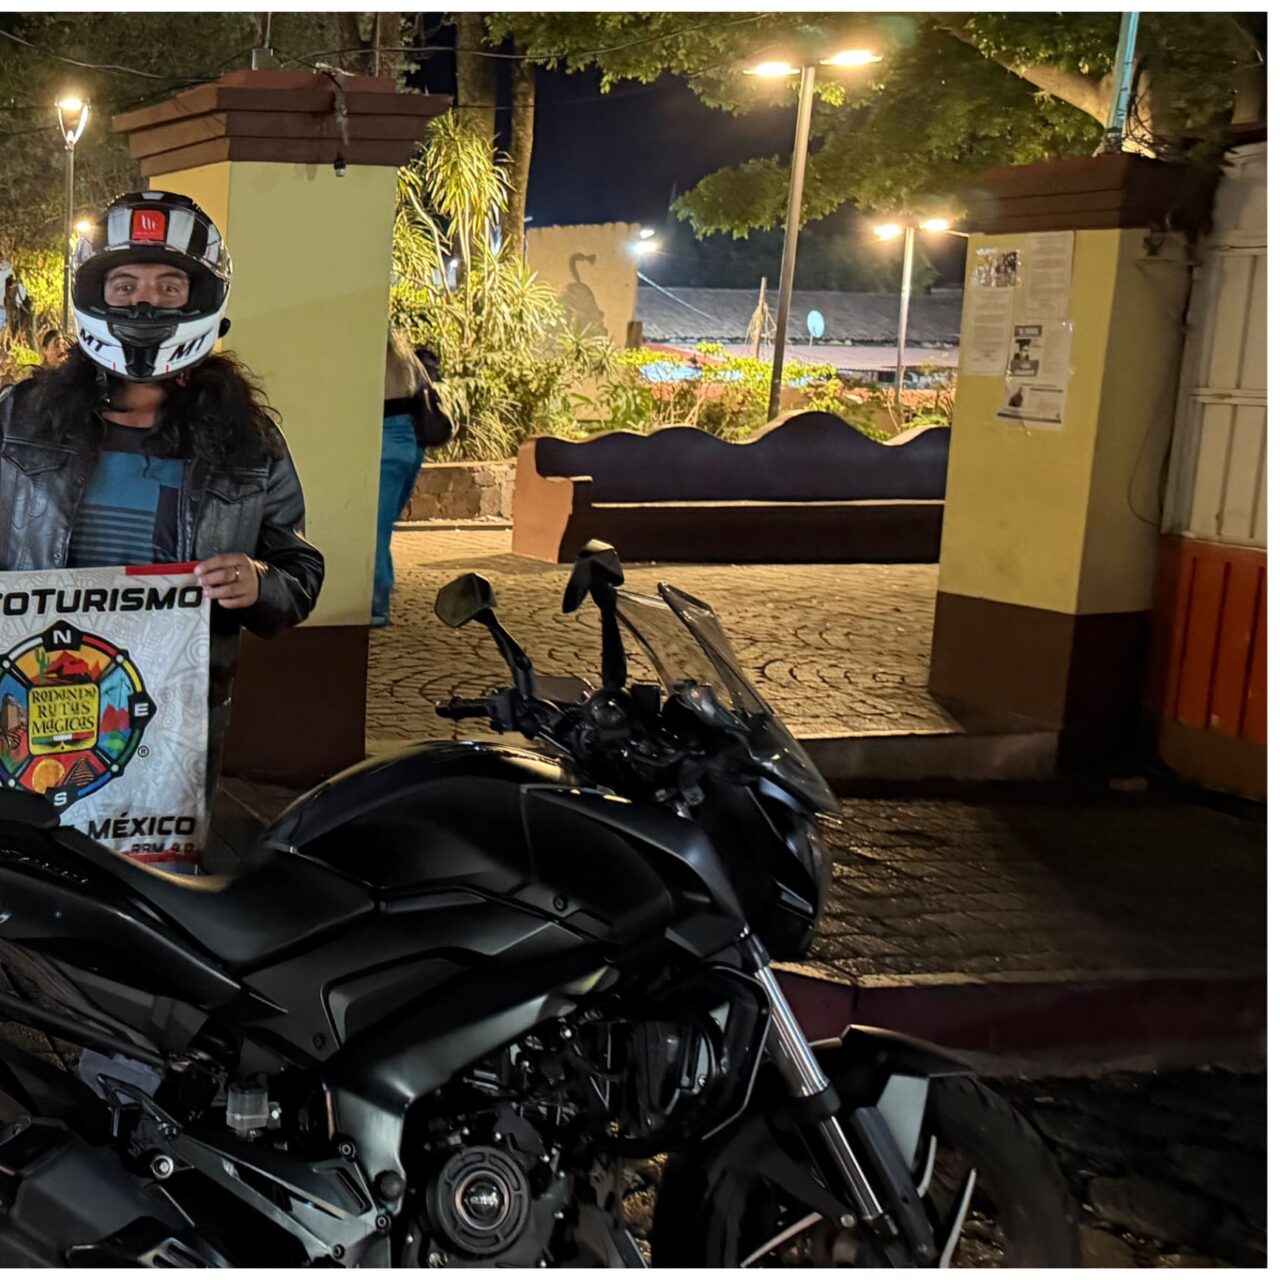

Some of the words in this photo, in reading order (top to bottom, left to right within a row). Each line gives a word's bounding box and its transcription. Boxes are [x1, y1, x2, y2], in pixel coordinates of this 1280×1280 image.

[79, 327, 108, 353] MT
[169, 330, 210, 362] MT
[52, 629, 72, 644] N
[133, 703, 150, 717] E
[53, 792, 68, 806] S
[87, 811, 196, 839] MÉXICO
